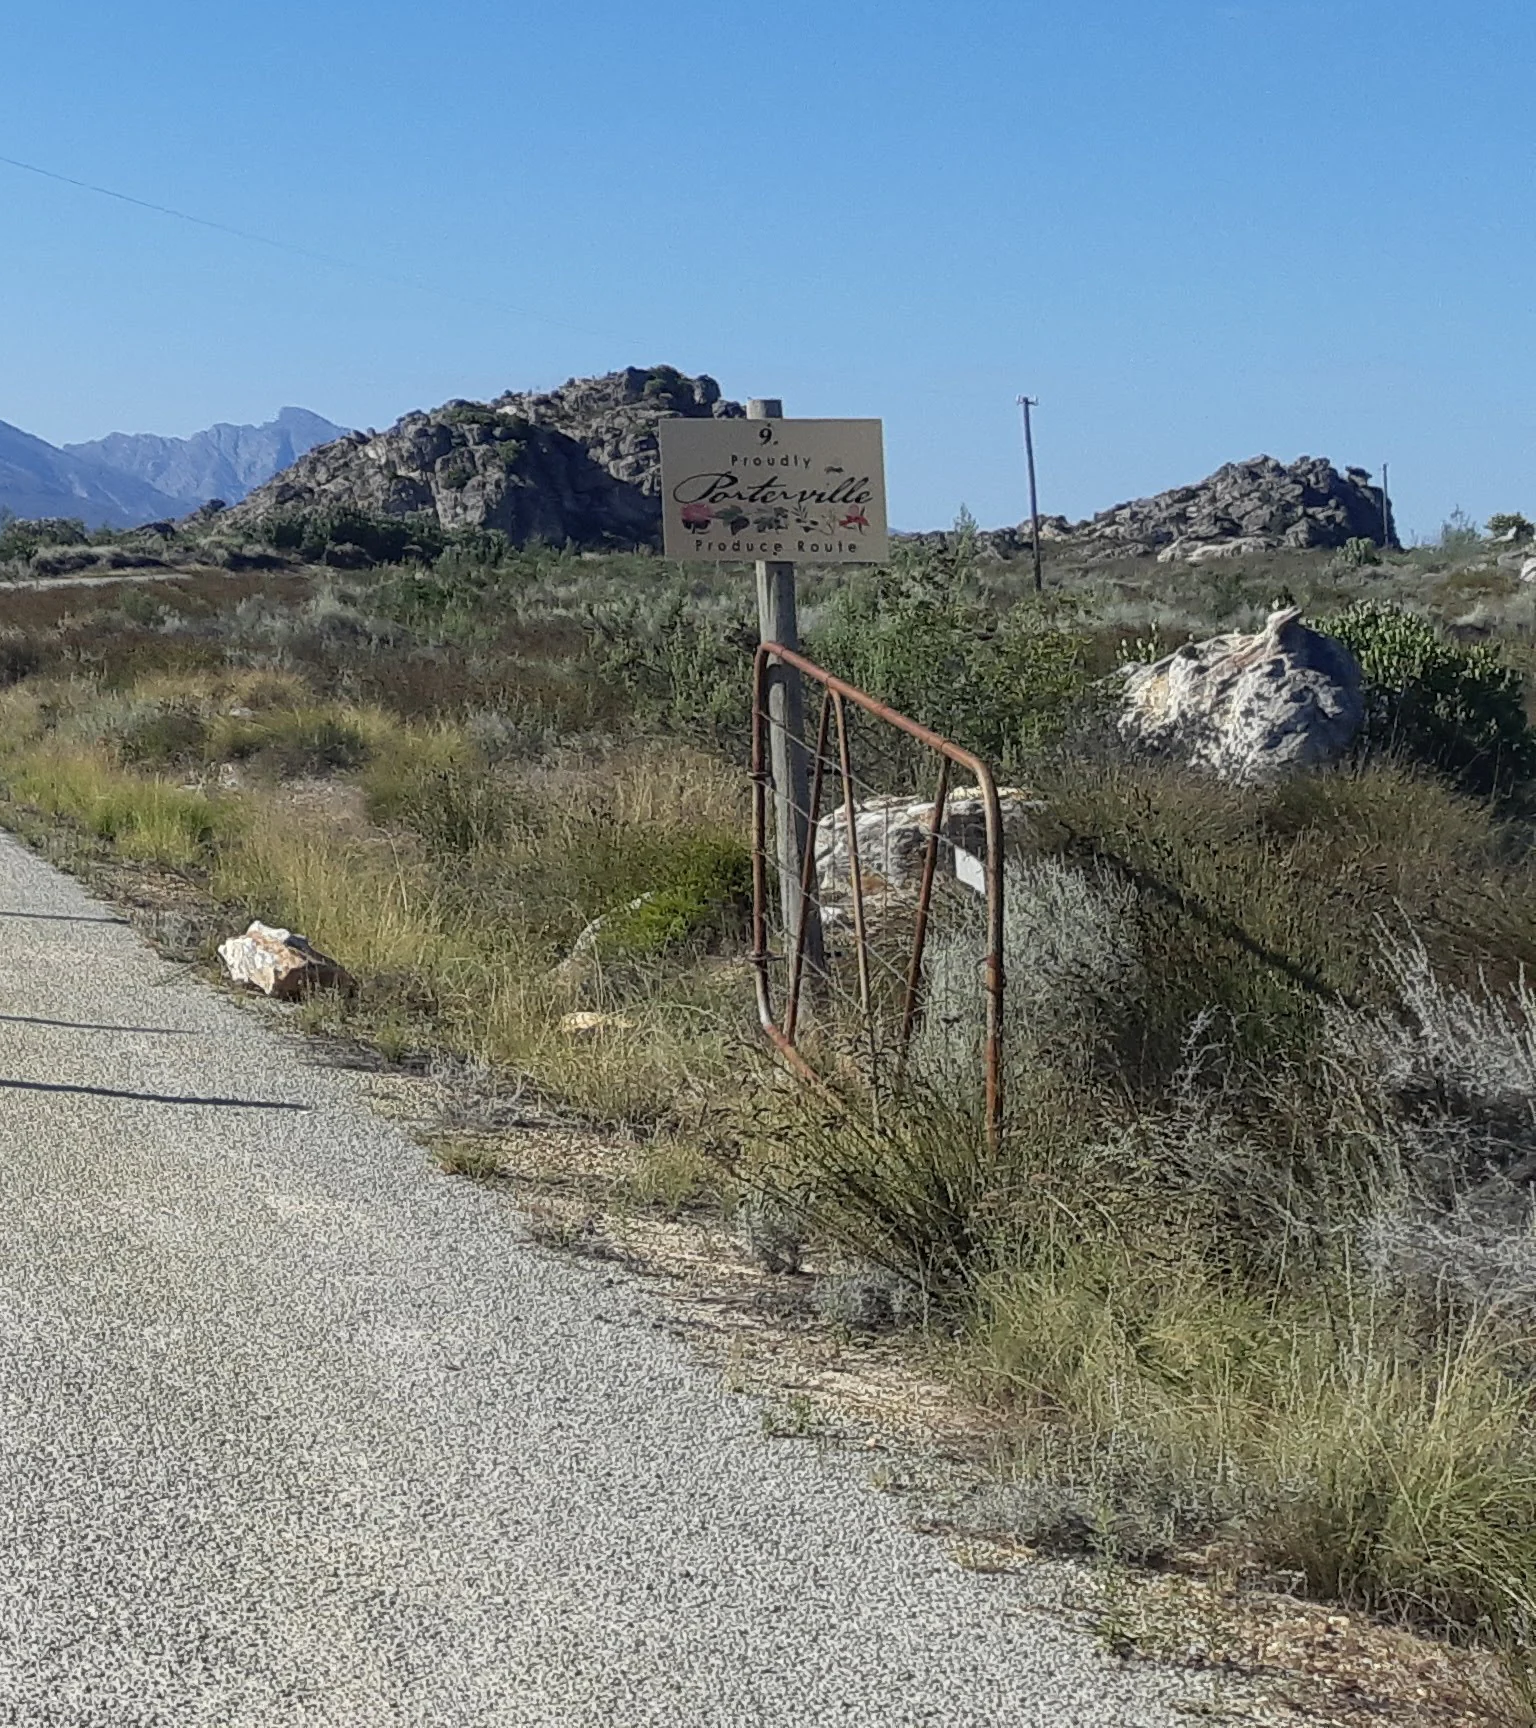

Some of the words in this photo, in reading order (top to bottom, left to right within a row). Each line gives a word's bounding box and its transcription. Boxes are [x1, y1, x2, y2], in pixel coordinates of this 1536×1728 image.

[731, 454, 812, 469] Proudly
[673, 471, 873, 505] Porterville
[695, 539, 783, 553] Produce
[797, 539, 858, 553] Route
